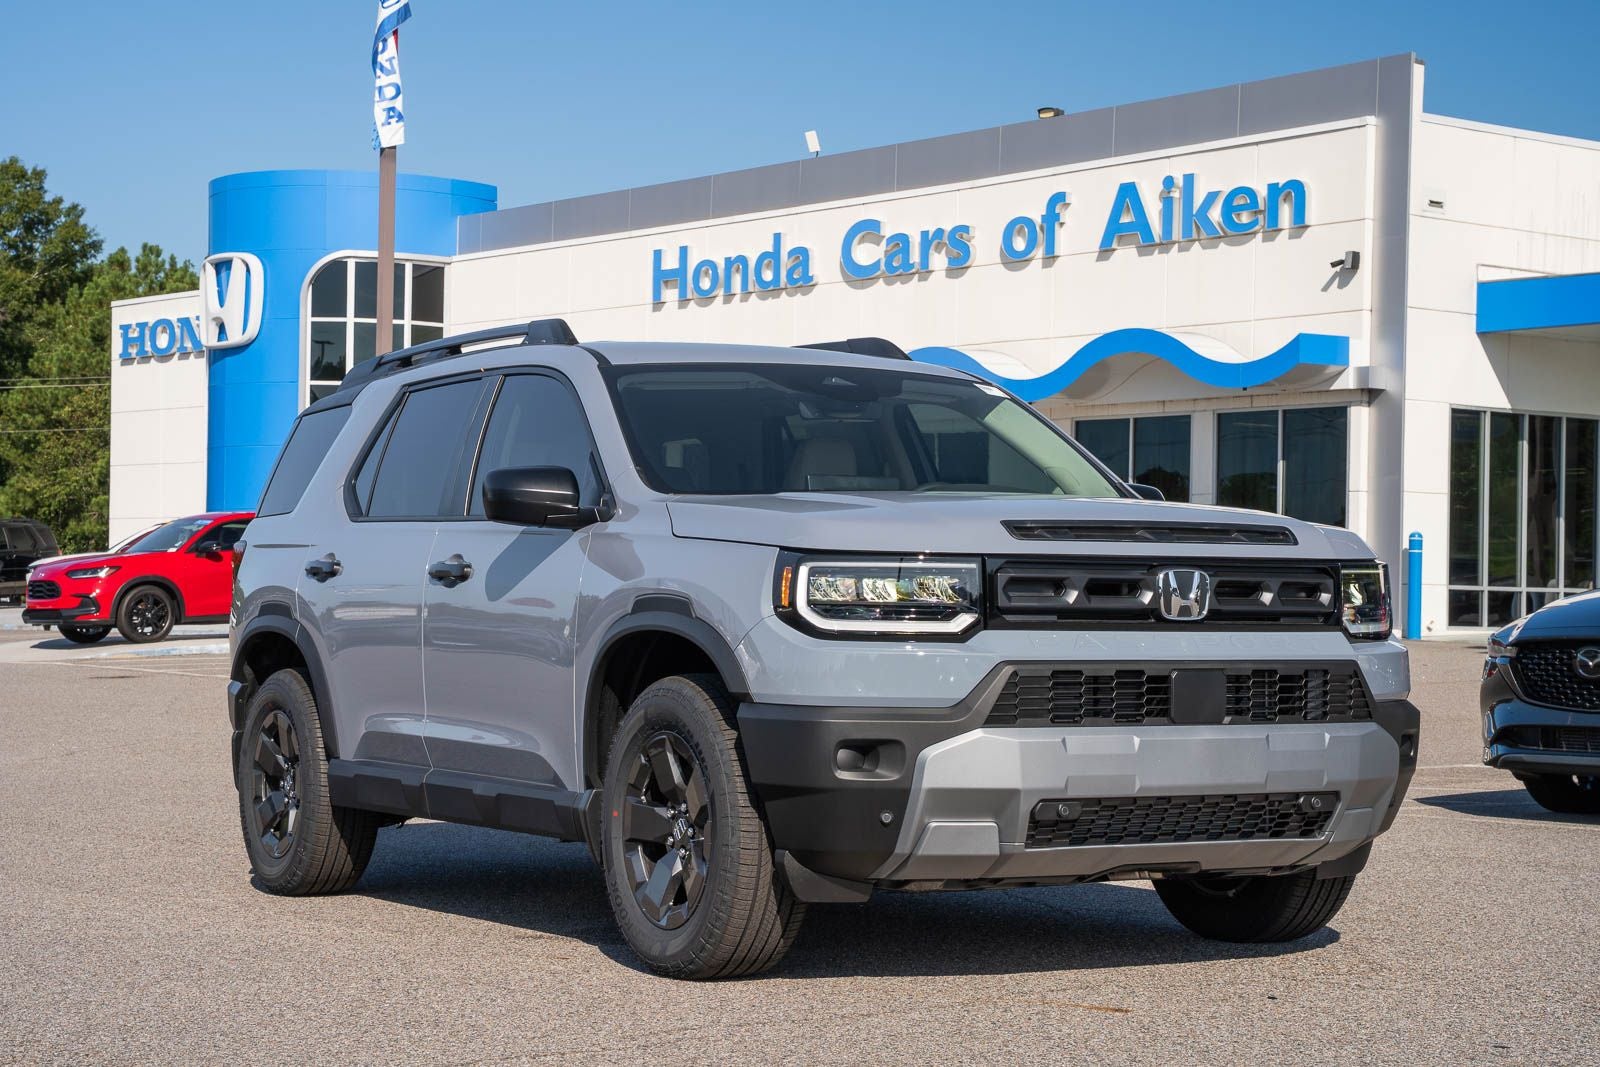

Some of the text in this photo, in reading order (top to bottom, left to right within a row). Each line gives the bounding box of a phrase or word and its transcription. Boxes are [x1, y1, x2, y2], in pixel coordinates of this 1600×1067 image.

[652, 172, 1307, 304] Honda Cars of Aiken
[119, 315, 204, 359] HON
